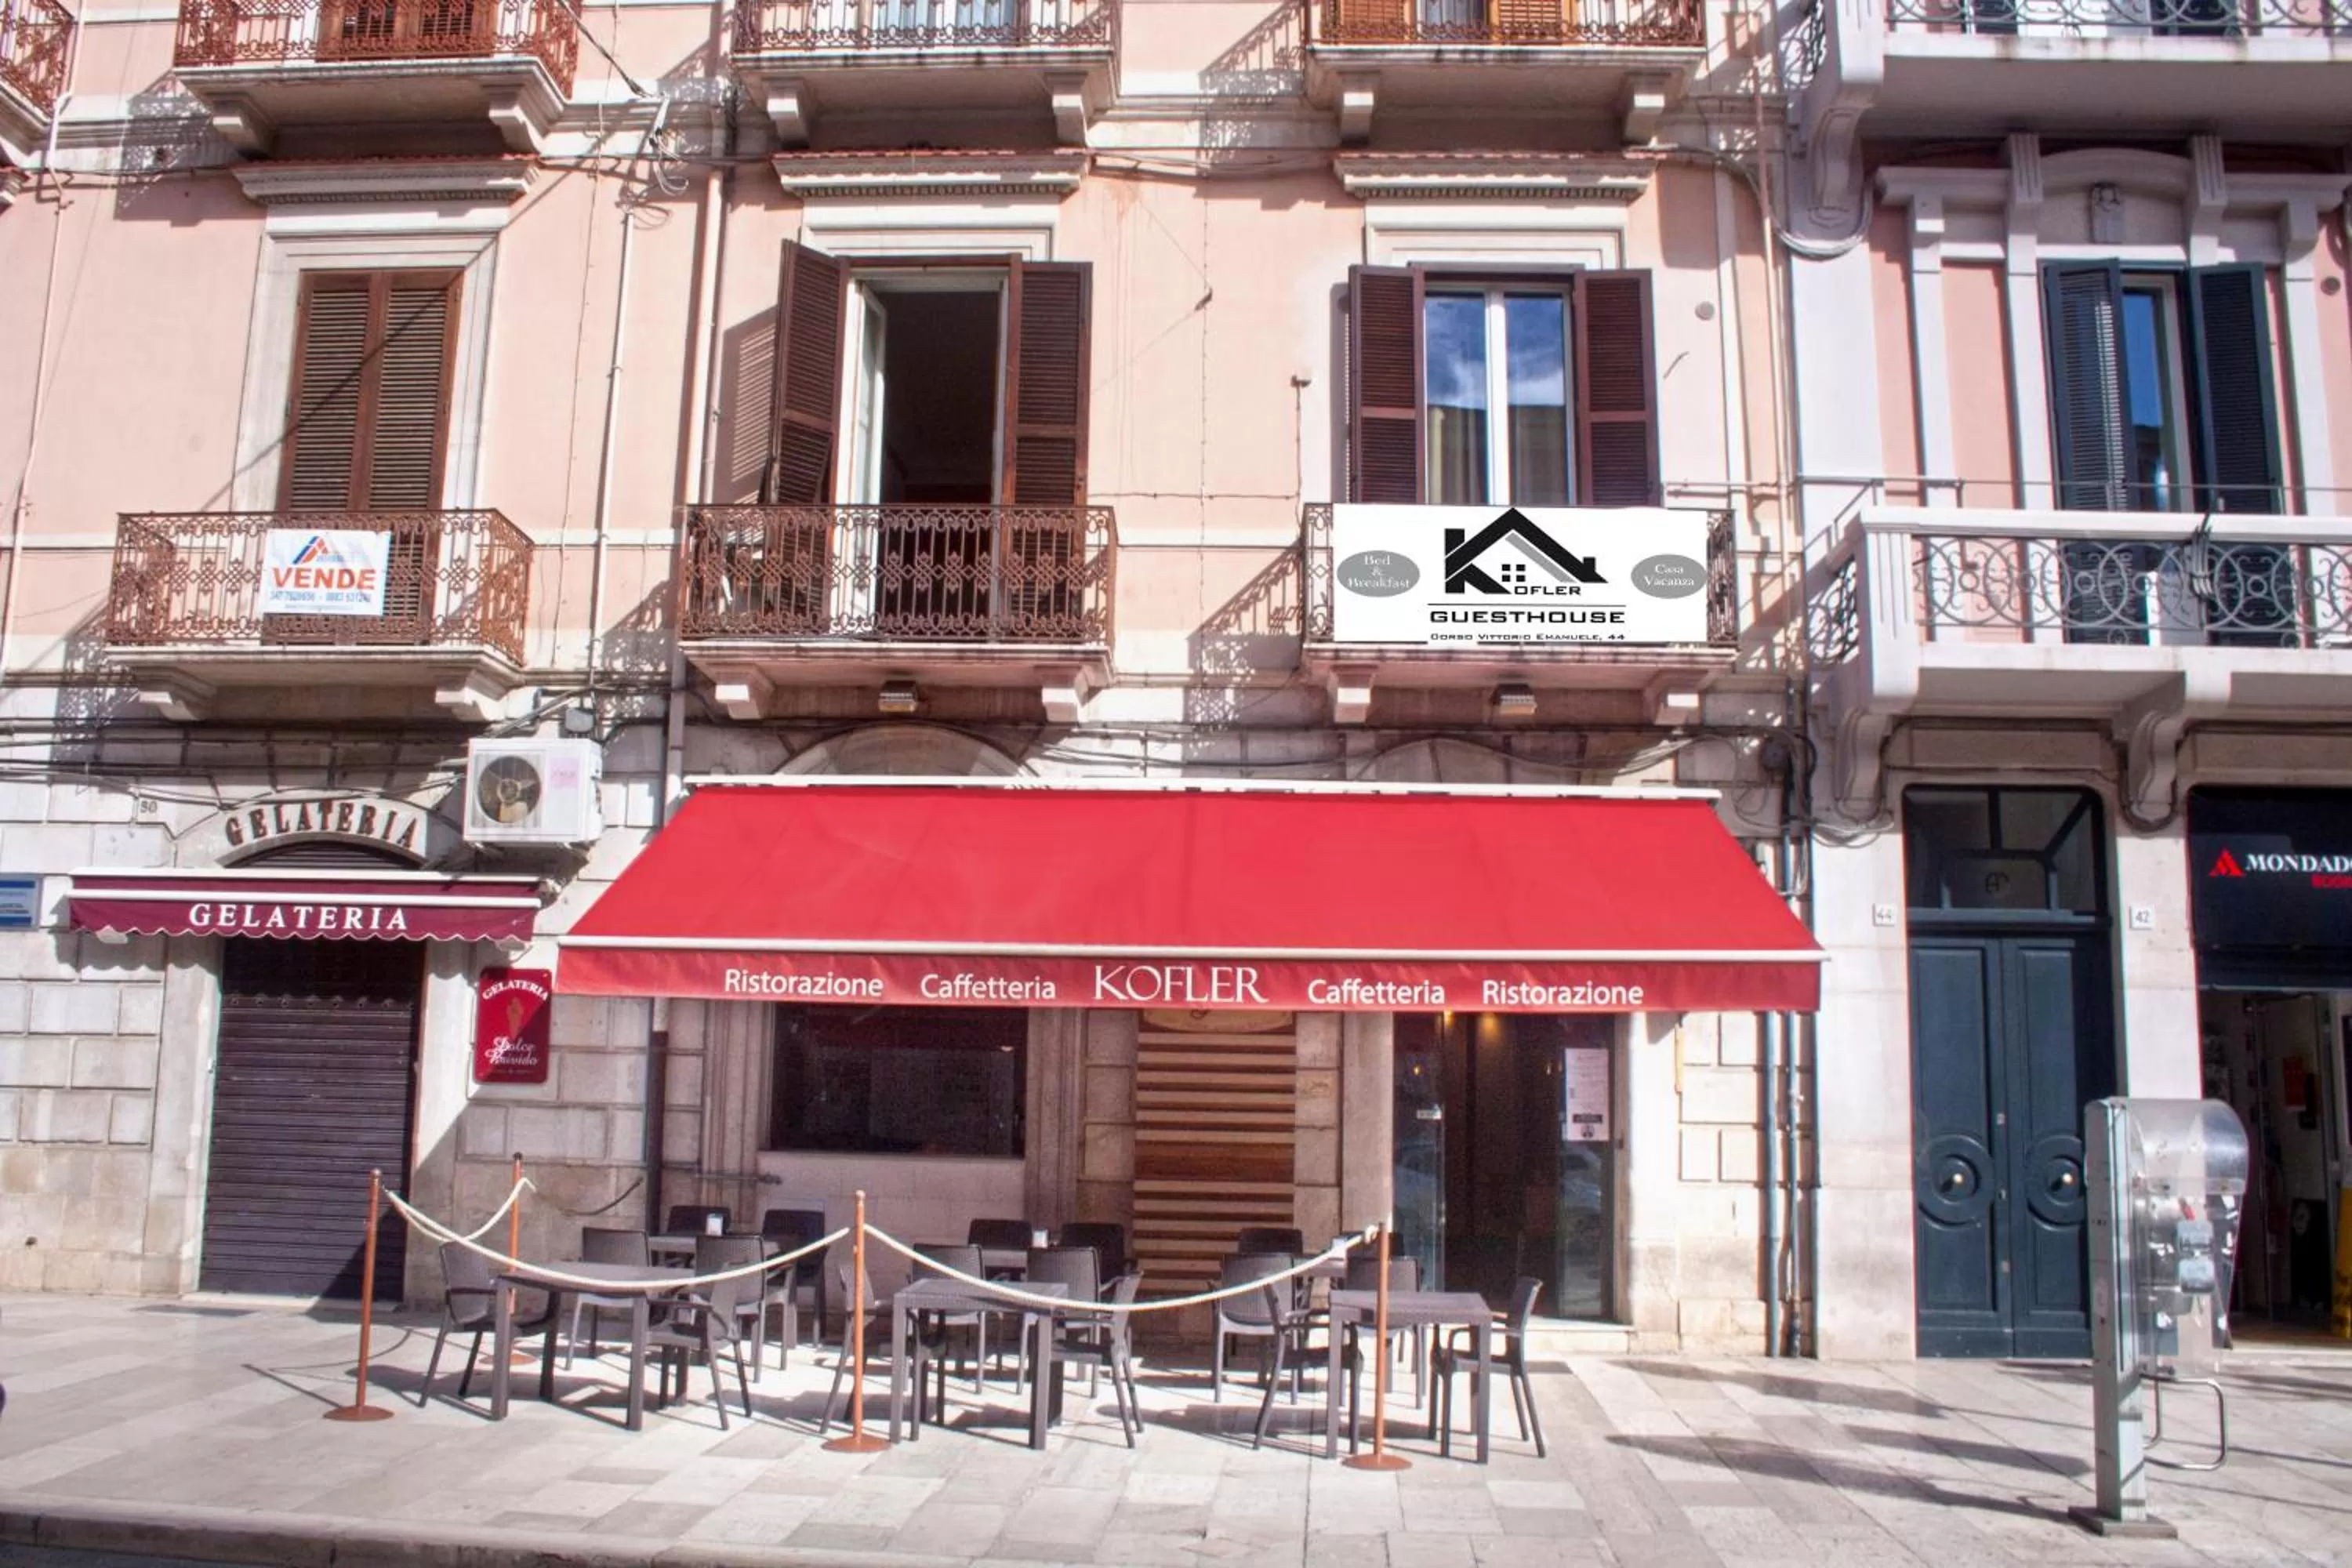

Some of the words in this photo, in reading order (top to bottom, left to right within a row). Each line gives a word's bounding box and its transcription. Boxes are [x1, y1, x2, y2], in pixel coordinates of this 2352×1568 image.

[1364, 554, 1391, 565] Bed
[1655, 564, 1685, 575] Casa
[273, 567, 376, 590] VENDE
[1348, 577, 1410, 589] Breakfast
[1643, 575, 1695, 586] Vacanza
[1430, 611, 1625, 623] GUESTHOUSE
[226, 800, 419, 849] GELATERIA
[2245, 853, 2352, 873] MONDAD
[188, 902, 408, 931] GELATERIA
[2135, 909, 2150, 924] 42
[482, 978, 548, 1001] GELATERIA
[724, 967, 884, 997] Ristorazione
[920, 973, 1056, 1000] Caffetteria
[1093, 965, 1269, 1004] KOFLER
[1307, 978, 1446, 1005] Caffetteria
[1482, 978, 1644, 1005] Ristorazione
